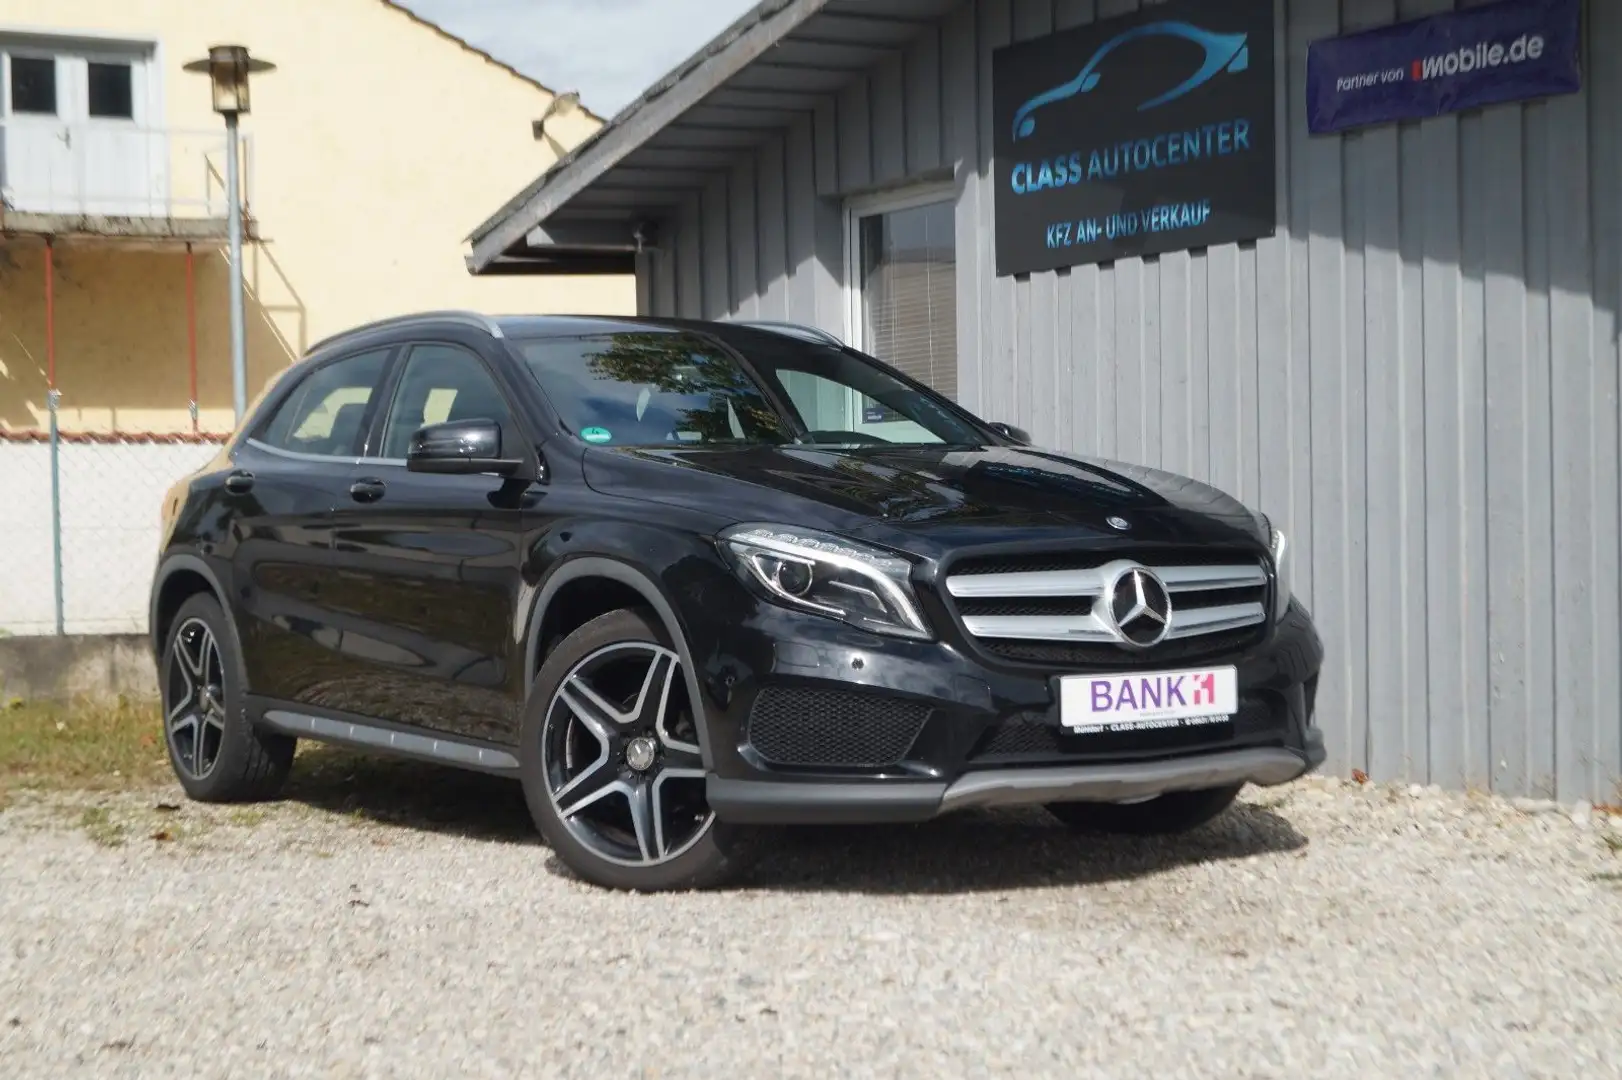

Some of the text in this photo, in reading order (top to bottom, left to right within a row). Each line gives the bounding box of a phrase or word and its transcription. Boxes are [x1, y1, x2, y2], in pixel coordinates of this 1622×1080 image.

[1336, 33, 1545, 93] Partner von mobile.de
[1011, 117, 1251, 194] CLASS AUTOCENTER
[1046, 199, 1212, 249] KFZ AN- UND VERKAUF
